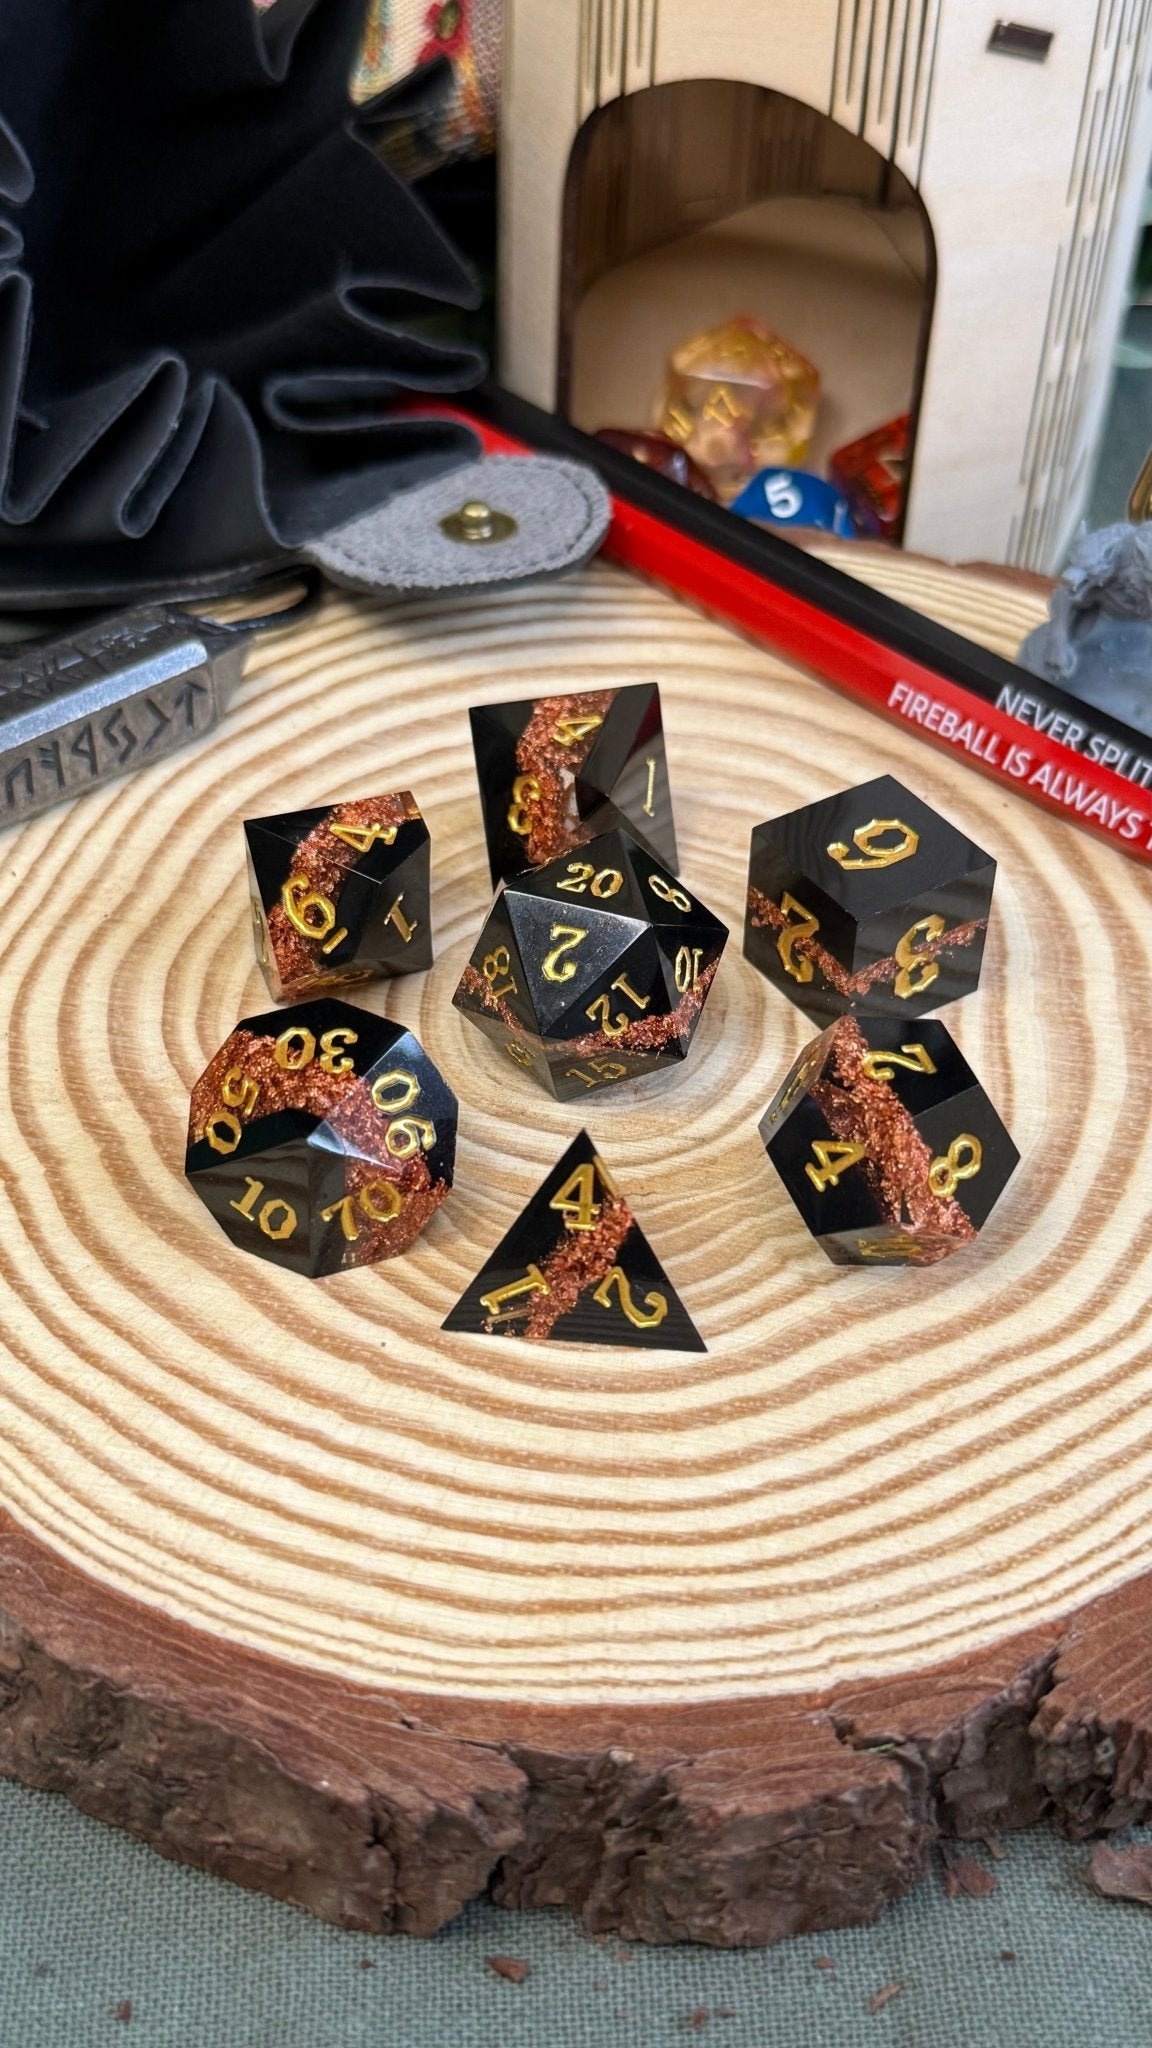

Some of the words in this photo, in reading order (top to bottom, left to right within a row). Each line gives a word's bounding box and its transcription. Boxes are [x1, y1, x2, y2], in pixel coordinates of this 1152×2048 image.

[764, 472, 802, 519] 5
[552, 715, 603, 746] 4
[995, 684, 1086, 751] NEVER
[1082, 734, 1152, 789] SPLIT
[643, 758, 656, 817] 1
[888, 682, 1000, 765] FIREBALL
[1001, 745, 1032, 778] IS
[1028, 763, 1143, 839] ALWAYS
[329, 823, 398, 852] 4
[557, 862, 623, 898] 20
[648, 875, 691, 913] 8
[384, 892, 417, 942] 1
[777, 891, 819, 983] 2
[483, 945, 517, 1003] 18
[541, 924, 588, 982] 2
[894, 914, 946, 999] 3
[586, 973, 649, 1036] 12
[275, 1027, 358, 1074] 30
[566, 1057, 627, 1088] 15
[861, 1044, 938, 1081] 2
[205, 1066, 260, 1155] 50
[805, 1140, 867, 1193] 4
[929, 1133, 982, 1197] 8
[230, 1176, 297, 1240] 10
[320, 1180, 401, 1241] 70
[549, 1163, 601, 1231] 4
[480, 1264, 549, 1315] 1
[593, 1266, 668, 1329] 2
